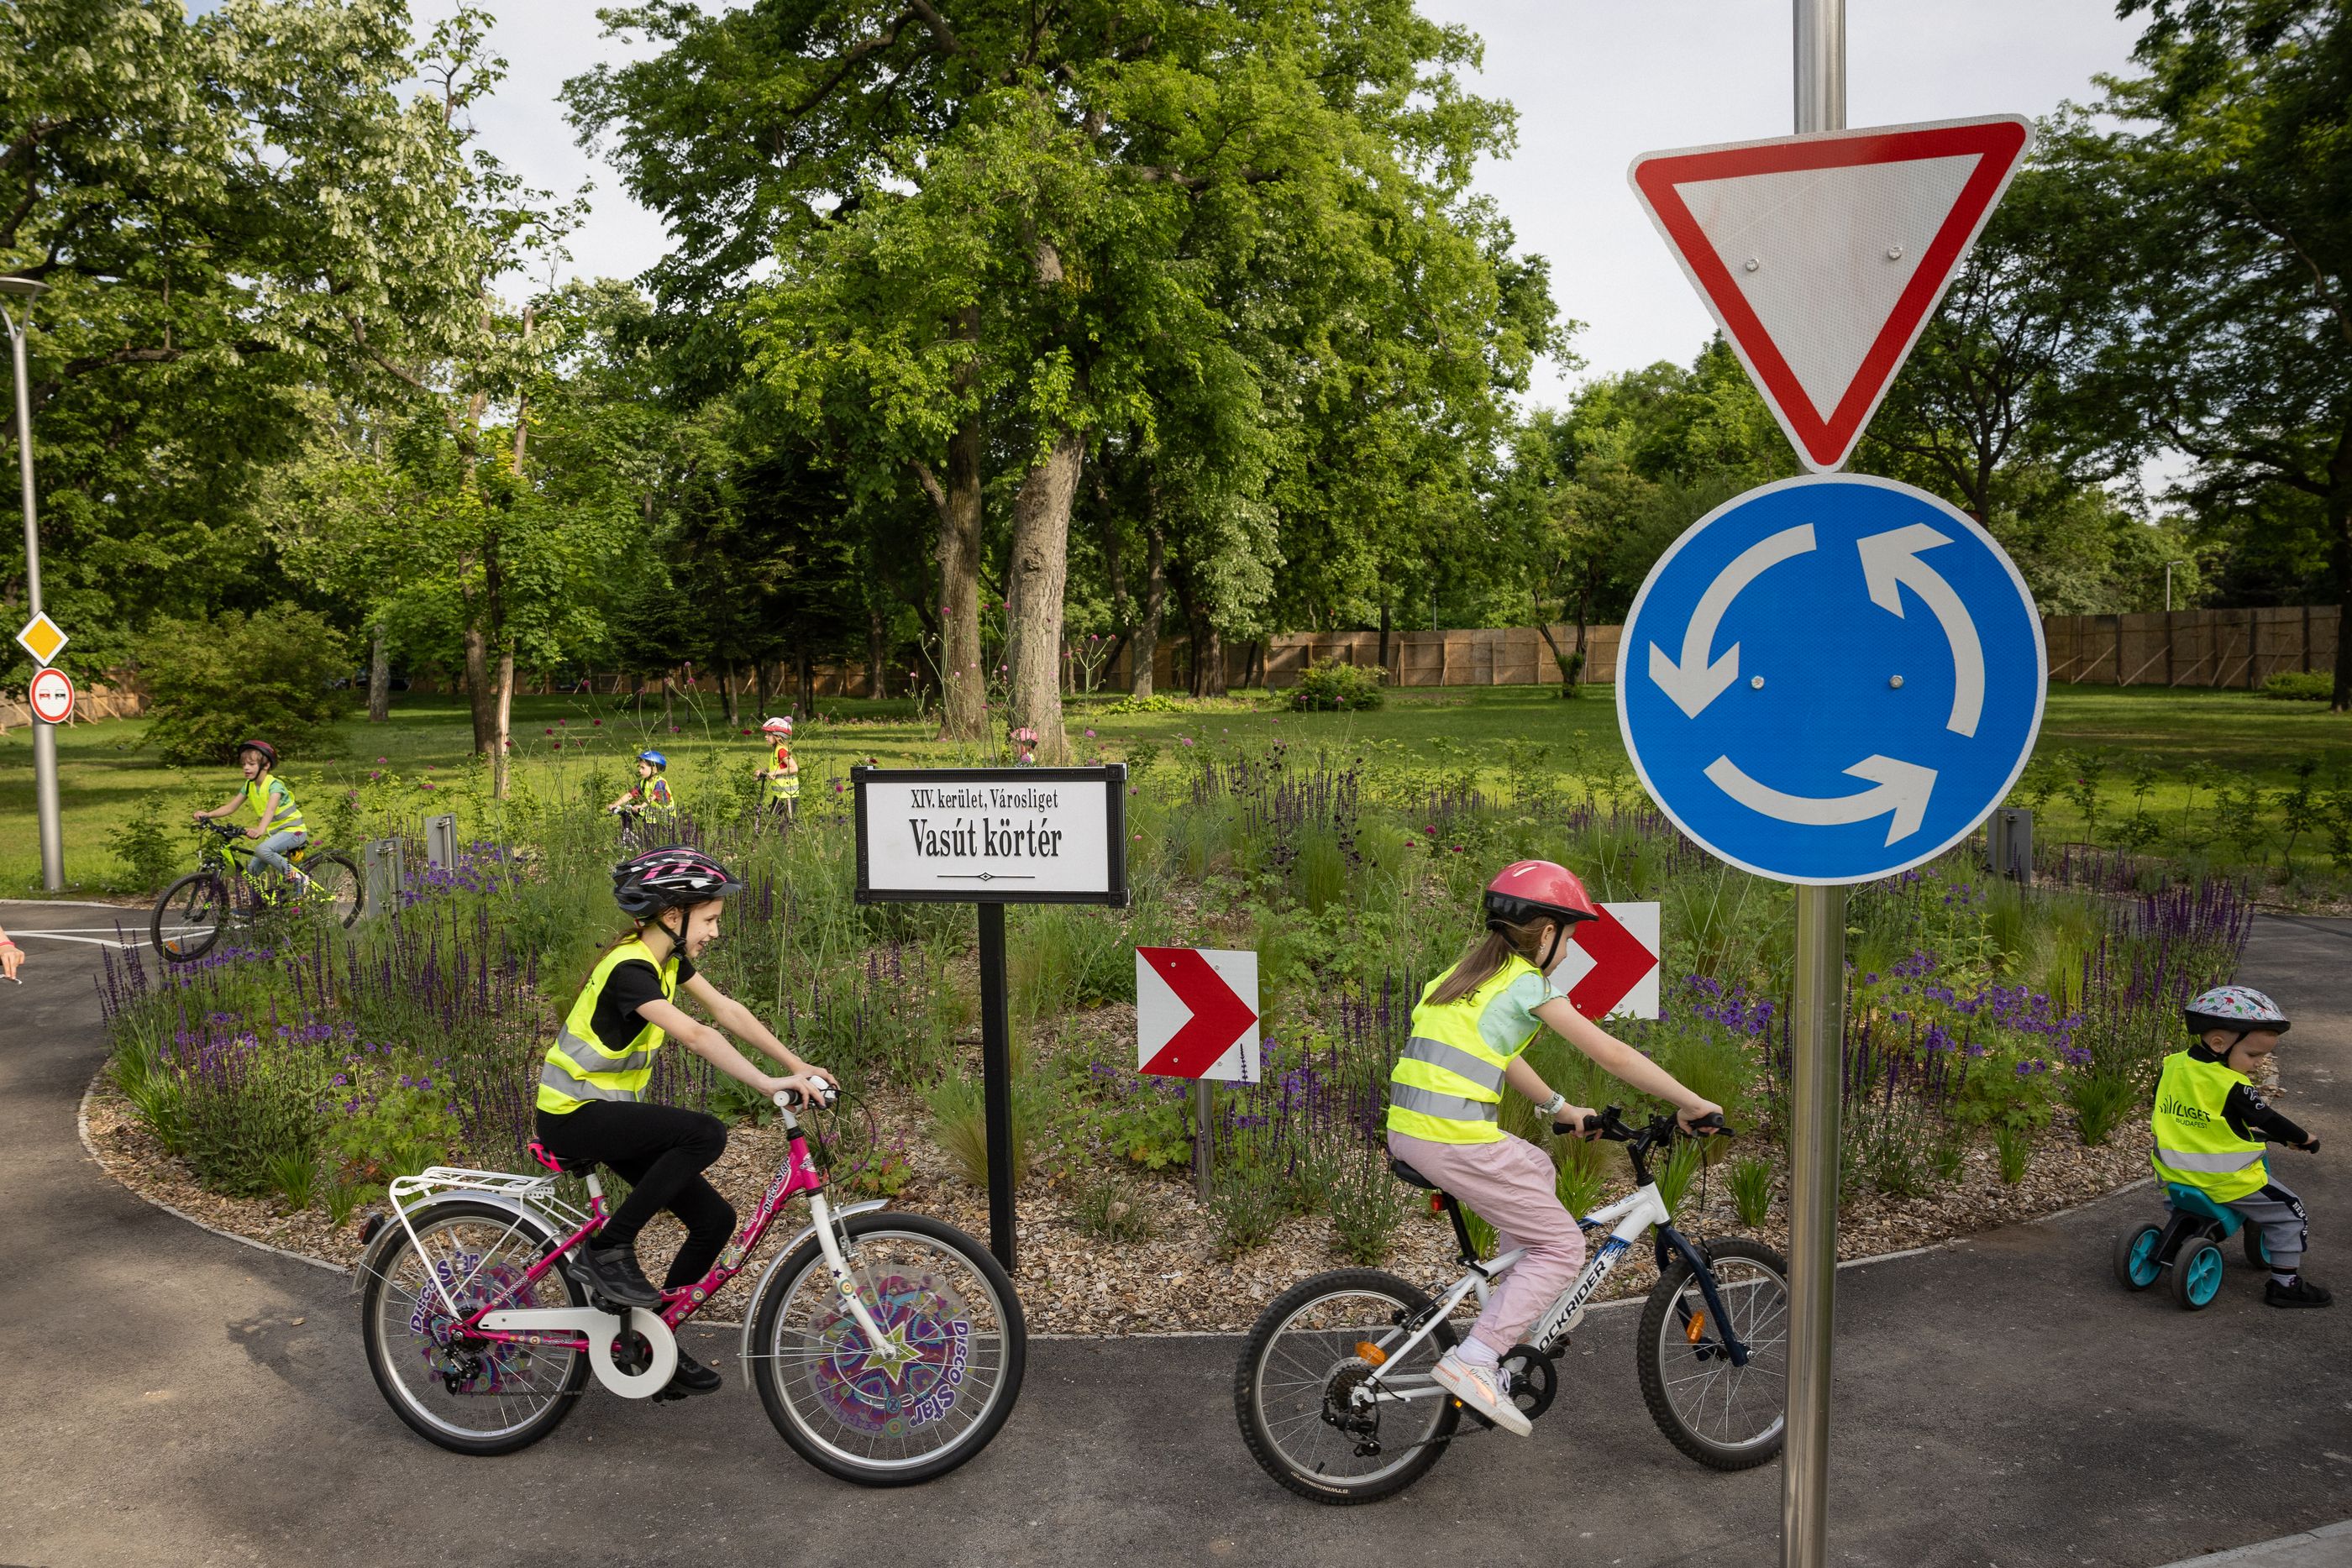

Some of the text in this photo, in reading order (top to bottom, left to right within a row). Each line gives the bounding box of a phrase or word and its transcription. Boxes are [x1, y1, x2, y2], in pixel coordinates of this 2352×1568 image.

[911, 788, 1058, 812] XIV. kerület, Városliget
[909, 817, 1062, 857] Vasút körtér
[2176, 1104, 2211, 1122] LIGET
[2176, 1118, 2208, 1129] BUDAPEST
[1539, 1260, 1606, 1352] OCKRIDER
[908, 1383, 957, 1427] Star
